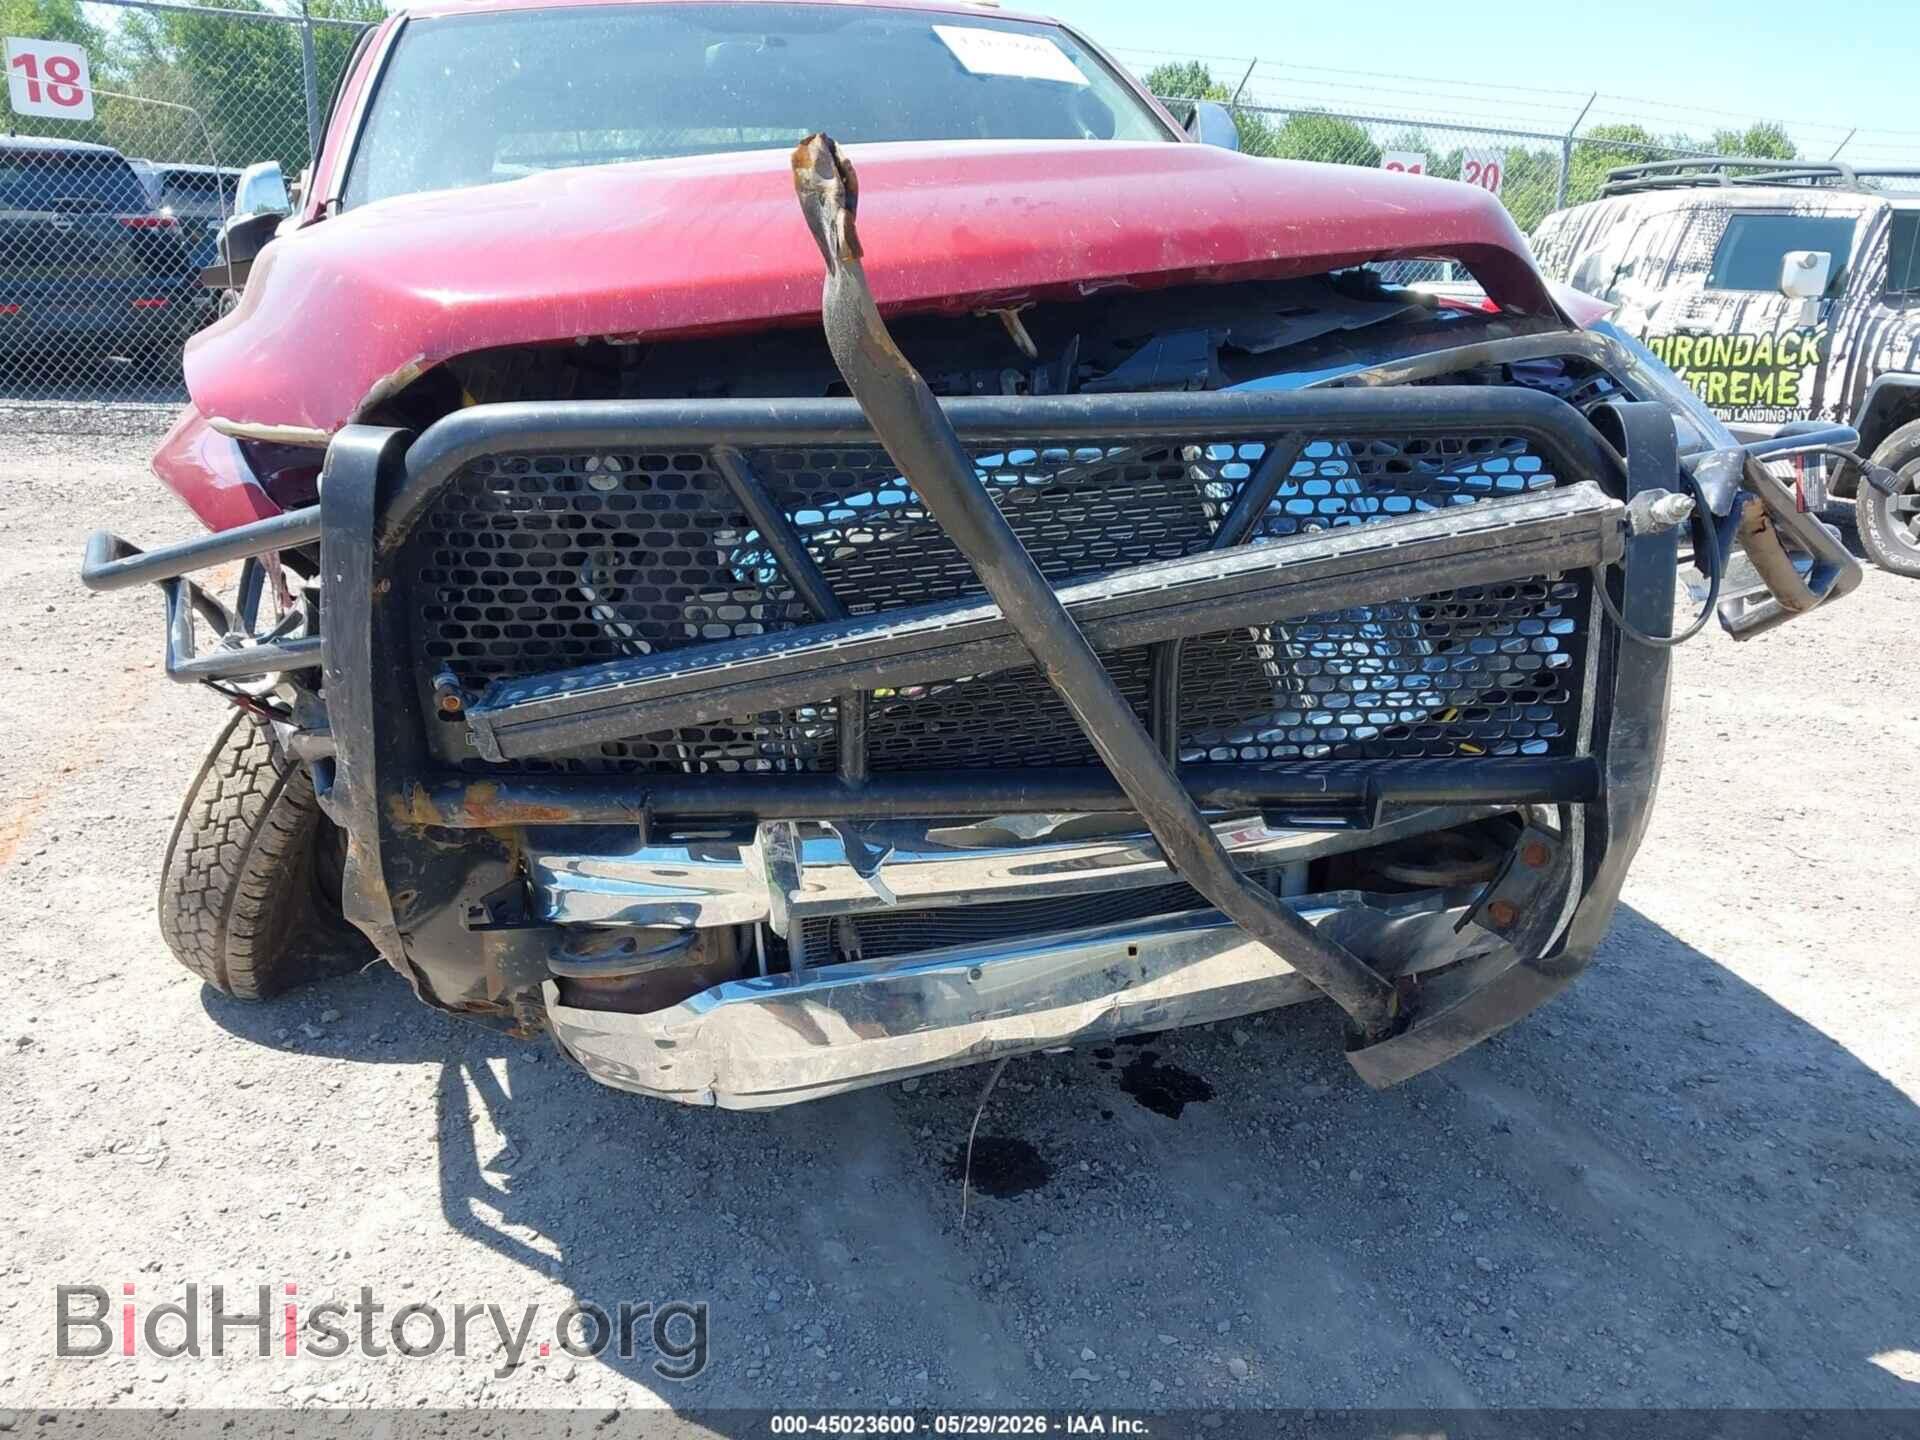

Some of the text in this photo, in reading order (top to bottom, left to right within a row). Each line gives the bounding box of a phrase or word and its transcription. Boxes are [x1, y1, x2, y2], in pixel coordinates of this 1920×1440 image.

[12, 53, 84, 107] 18
[1464, 160, 1500, 193] 20
[1638, 329, 1828, 368] DIRONDACK
[1684, 369, 1801, 406] TREME
